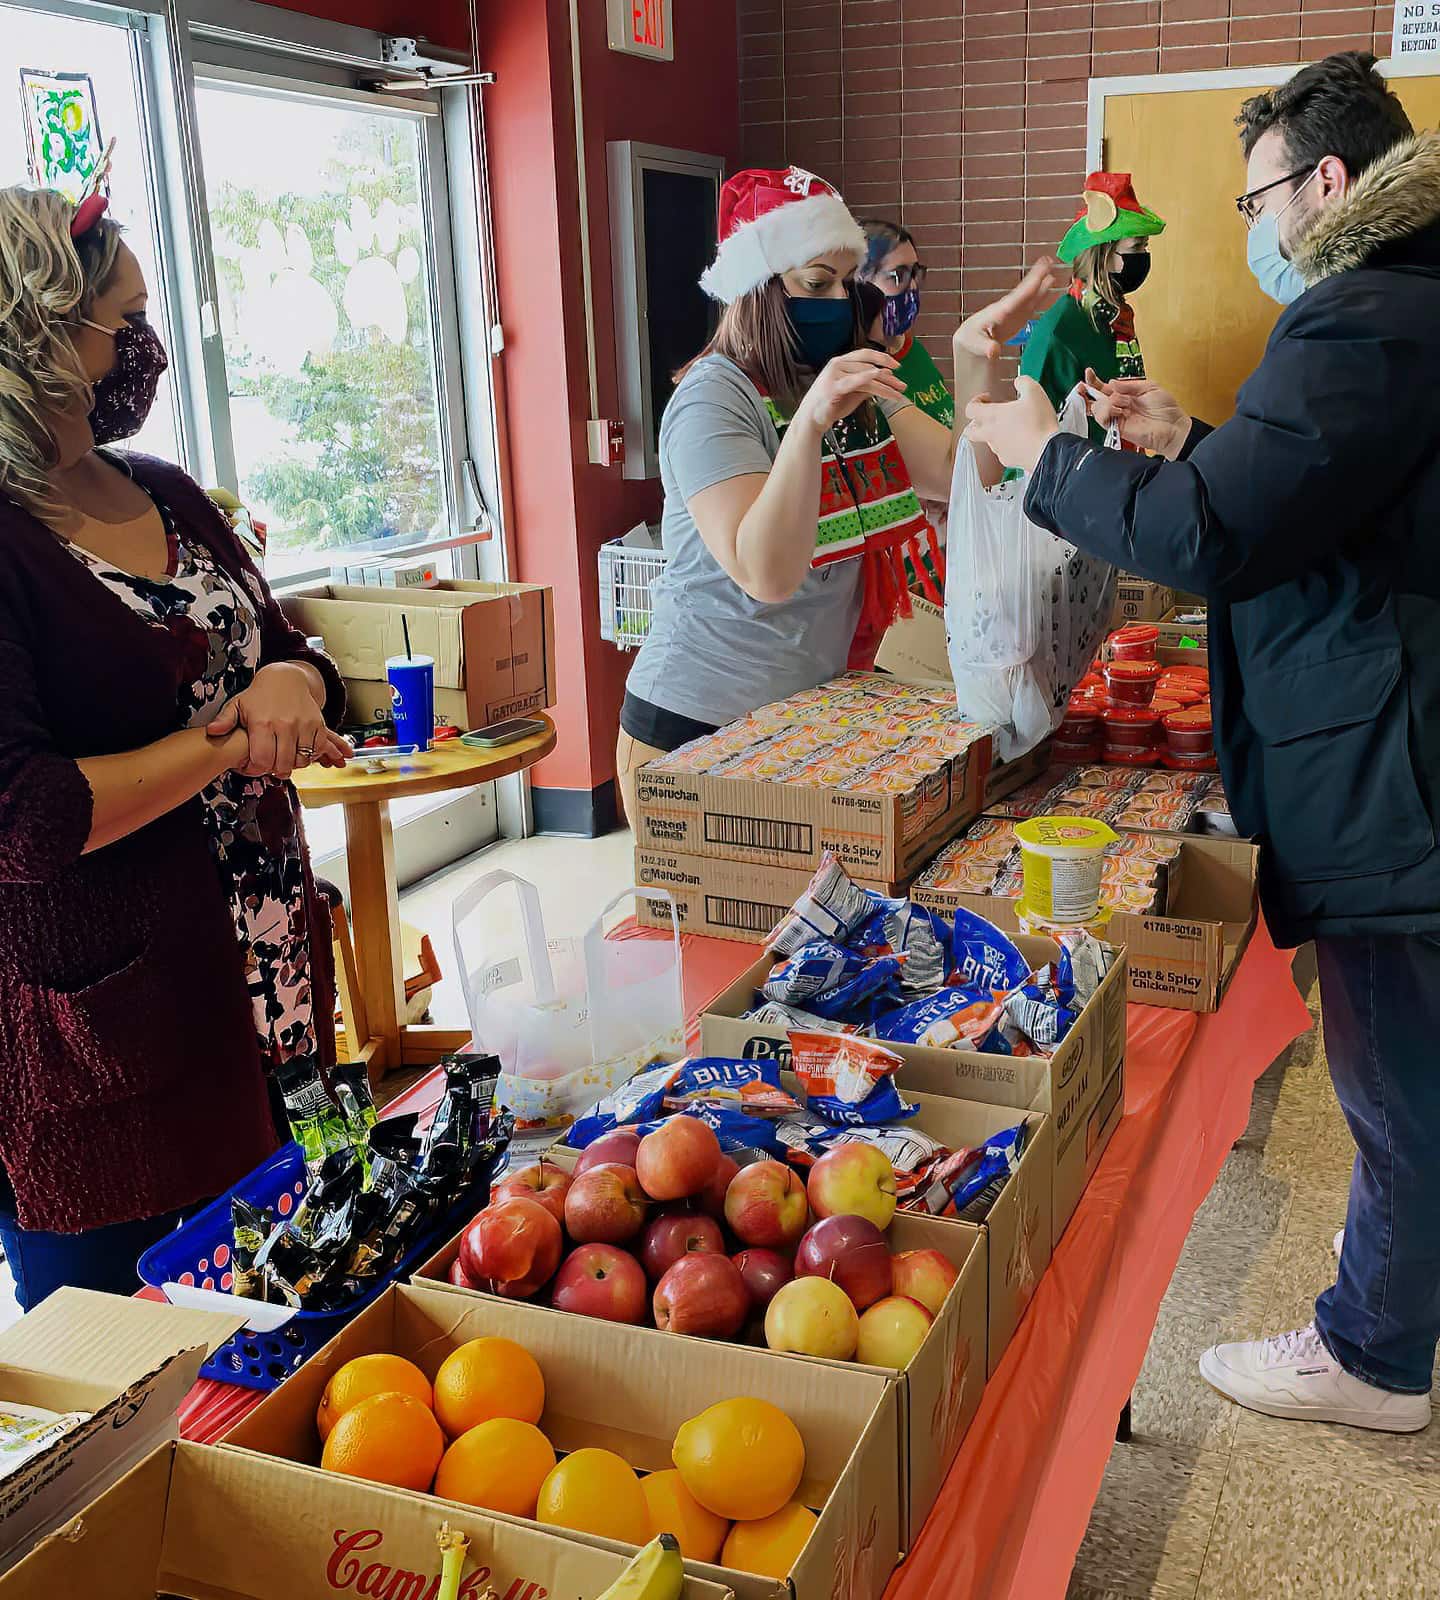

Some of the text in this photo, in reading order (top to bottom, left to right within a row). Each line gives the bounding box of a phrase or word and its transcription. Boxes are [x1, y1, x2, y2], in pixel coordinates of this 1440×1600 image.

[1404, 5, 1424, 18] NO
[631, 0, 664, 48] EXIT
[1403, 21, 1440, 35] BEVERA
[1401, 38, 1437, 52] BEYOND
[491, 693, 541, 721] GATORADE
[665, 776, 676, 786] OZ
[649, 786, 699, 802] Maruchan
[646, 816, 688, 832] Instant
[820, 840, 882, 860] Hot & Spicy
[650, 868, 701, 886] Maruchan
[914, 892, 959, 906] 12/2.25 OZ
[1129, 967, 1202, 989] Hot & Spicy
[1132, 978, 1176, 993] Chicken
